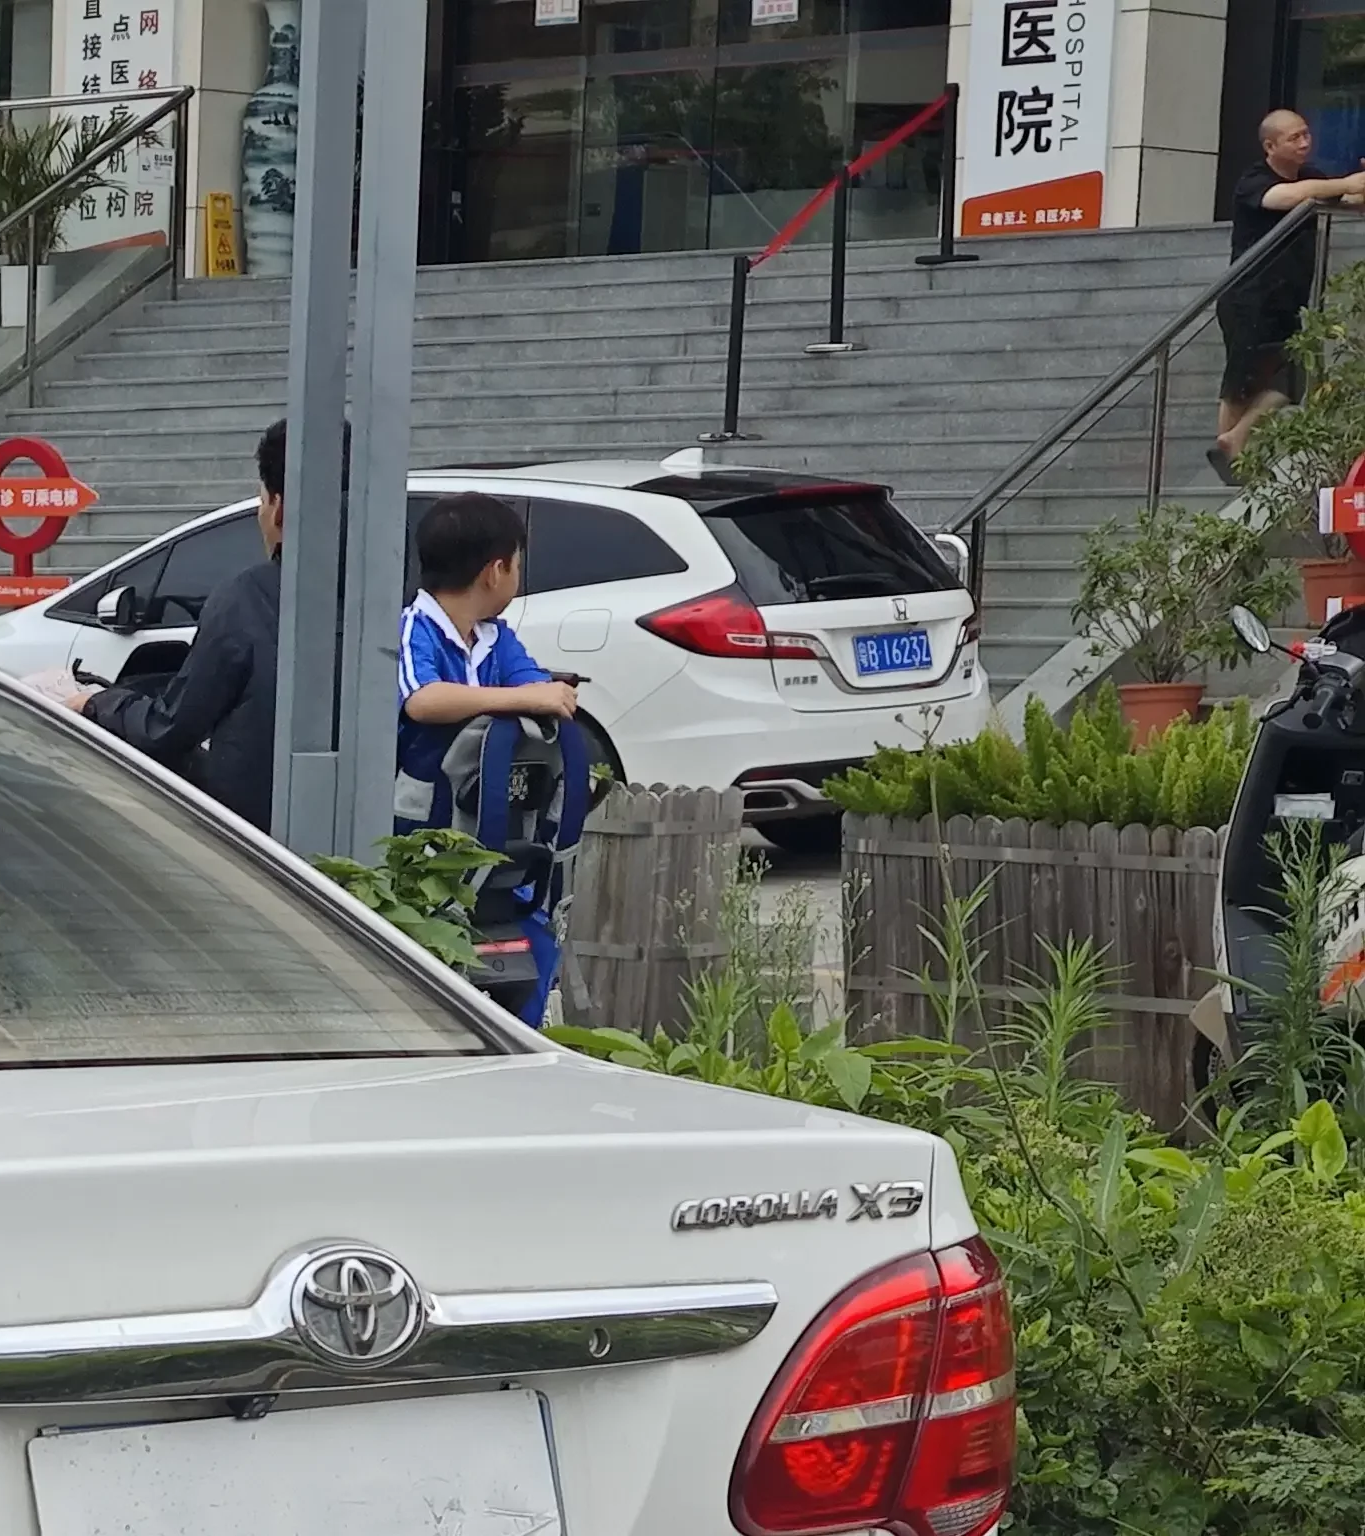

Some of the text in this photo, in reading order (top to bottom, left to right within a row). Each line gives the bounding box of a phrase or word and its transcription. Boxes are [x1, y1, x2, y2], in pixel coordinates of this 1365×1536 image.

[77, 0, 102, 221] 直接结算位
[995, 0, 1058, 157] 医院
[671, 1180, 924, 1231] COROLLA X3
